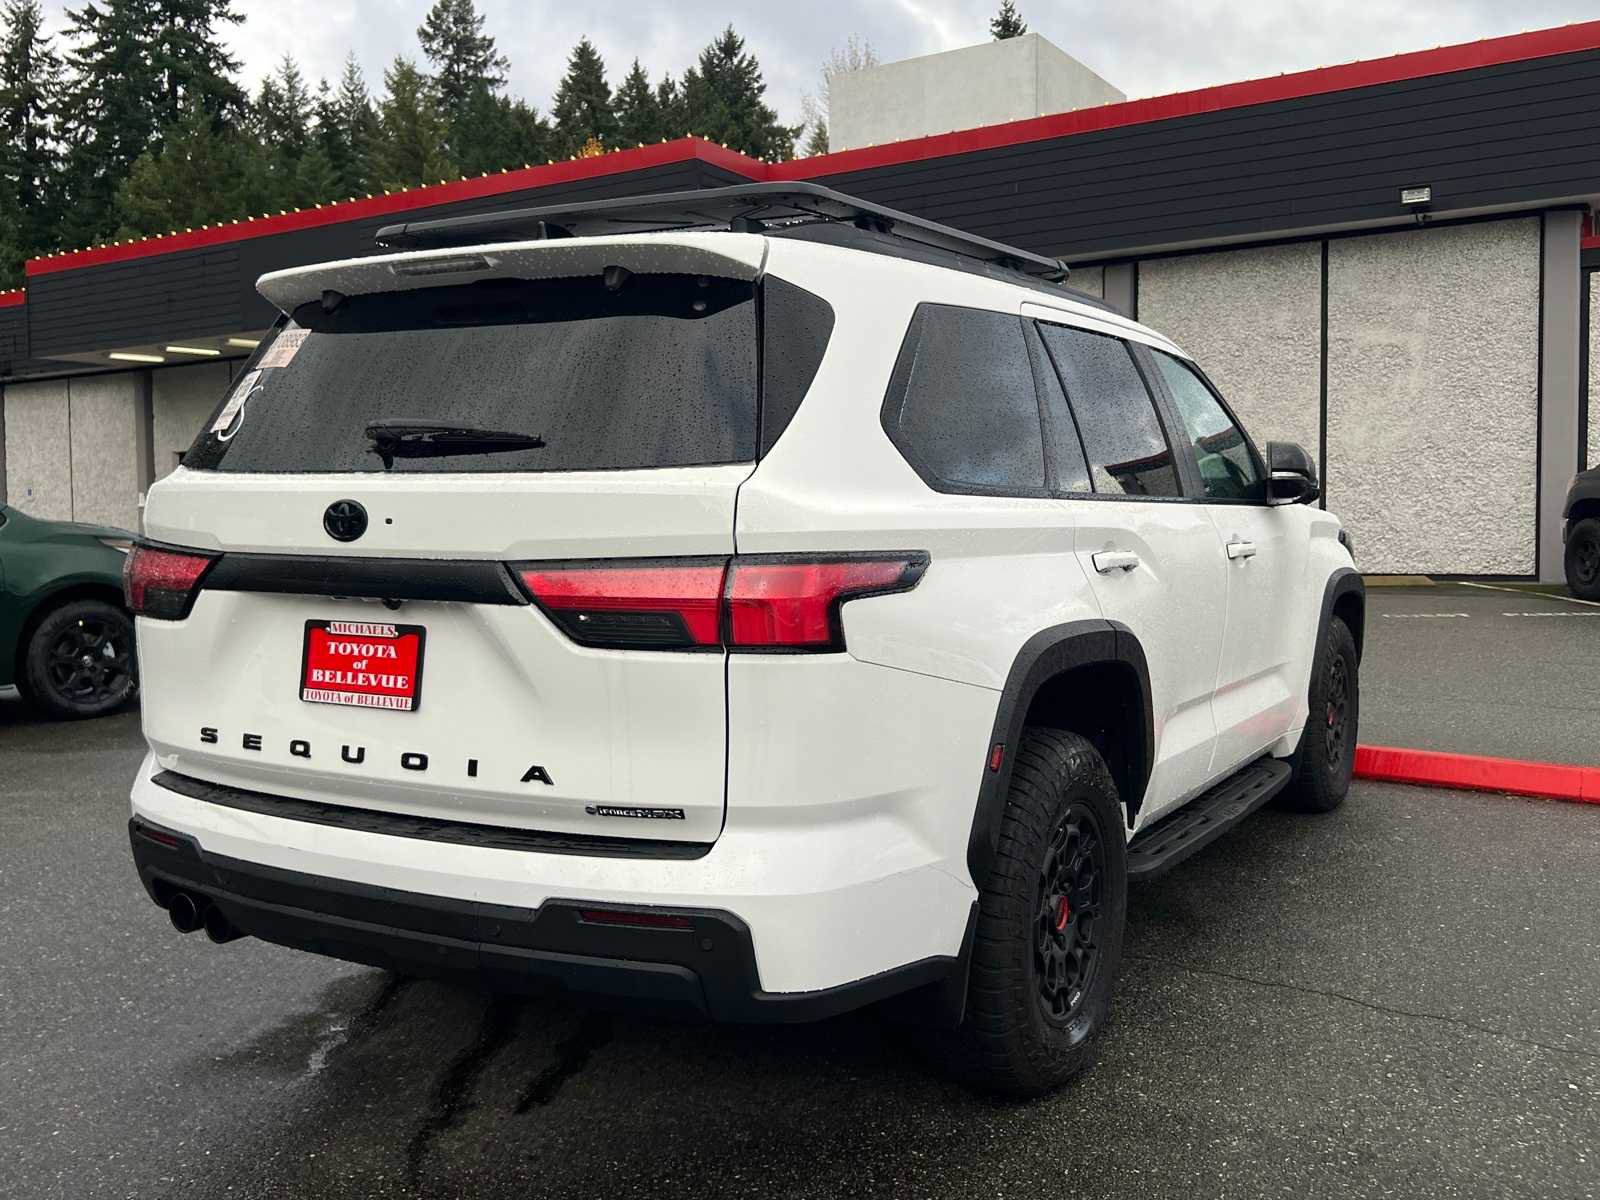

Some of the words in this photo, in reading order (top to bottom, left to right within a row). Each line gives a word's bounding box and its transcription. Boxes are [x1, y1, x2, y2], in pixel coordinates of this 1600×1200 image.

[331, 623, 395, 636] MICHAELS
[327, 641, 397, 658] TOYOTA
[352, 660, 368, 670] of
[312, 669, 409, 689] BELLEVUE
[304, 690, 342, 702] TOYOTA
[344, 695, 355, 704] of
[357, 695, 411, 709] BELLEVUE
[200, 727, 554, 786] SEQUOIA
